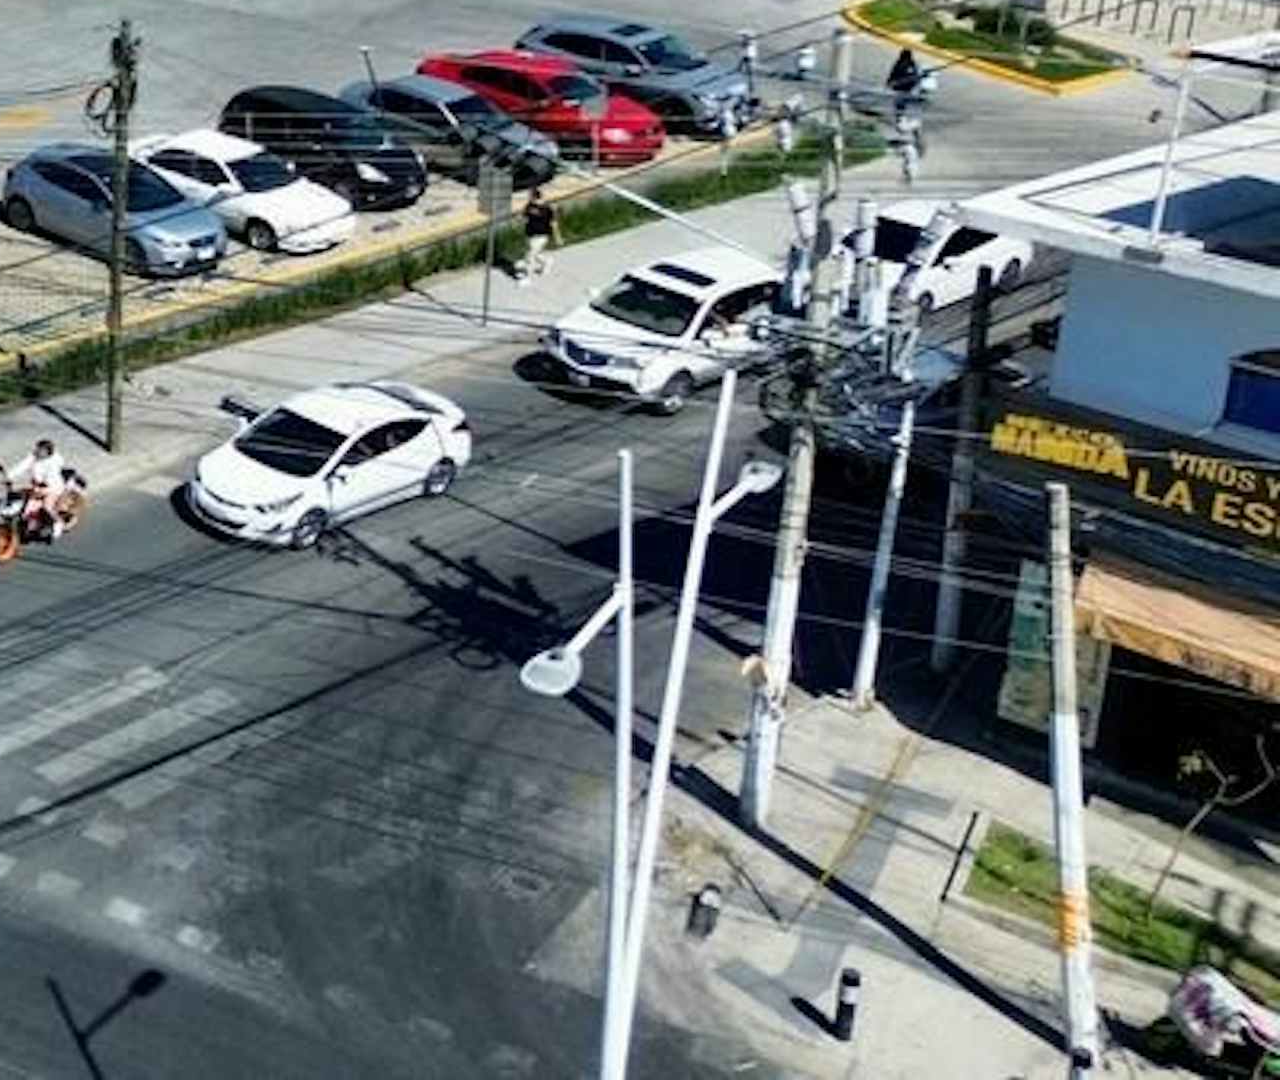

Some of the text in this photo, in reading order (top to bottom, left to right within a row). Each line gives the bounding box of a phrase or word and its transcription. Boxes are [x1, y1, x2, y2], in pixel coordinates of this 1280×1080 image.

[1170, 450, 1256, 492] VINOS
[1134, 467, 1280, 539] LA ES
